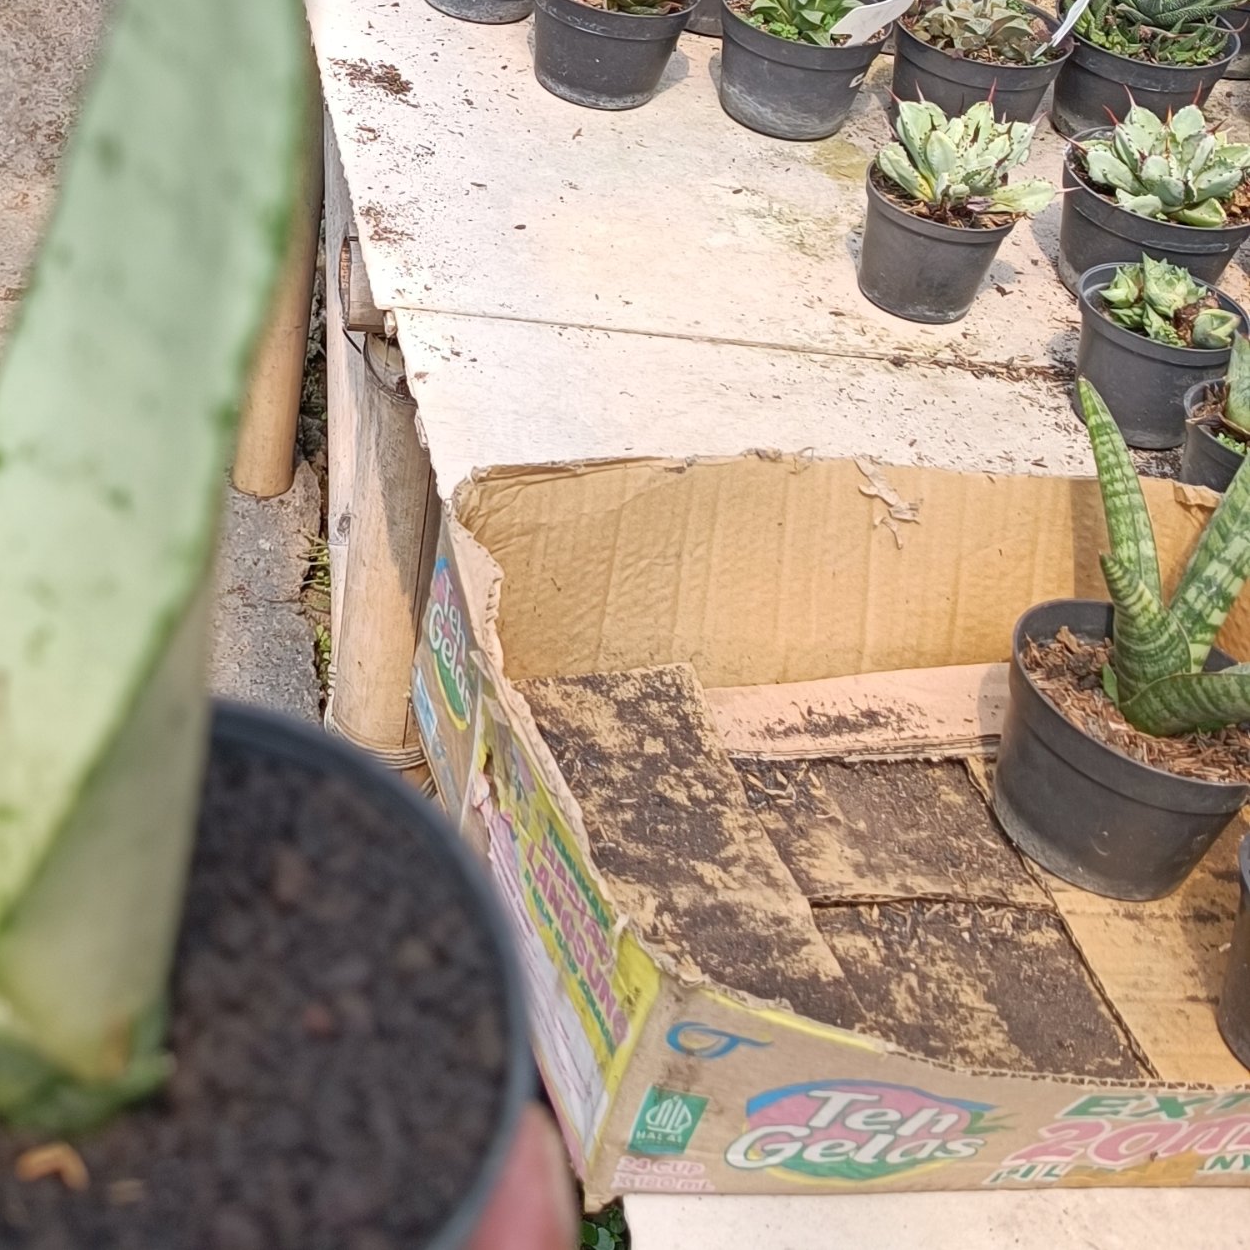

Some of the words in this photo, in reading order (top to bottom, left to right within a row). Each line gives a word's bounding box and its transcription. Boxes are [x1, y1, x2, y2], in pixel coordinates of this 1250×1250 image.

[442, 567, 467, 664] Teh
[427, 602, 474, 726] Gelas
[525, 840, 631, 1047] LANGSUNG
[724, 1124, 987, 1170] Gelas
[805, 1089, 960, 1137] Teh
[652, 1159, 706, 1175] CUP
